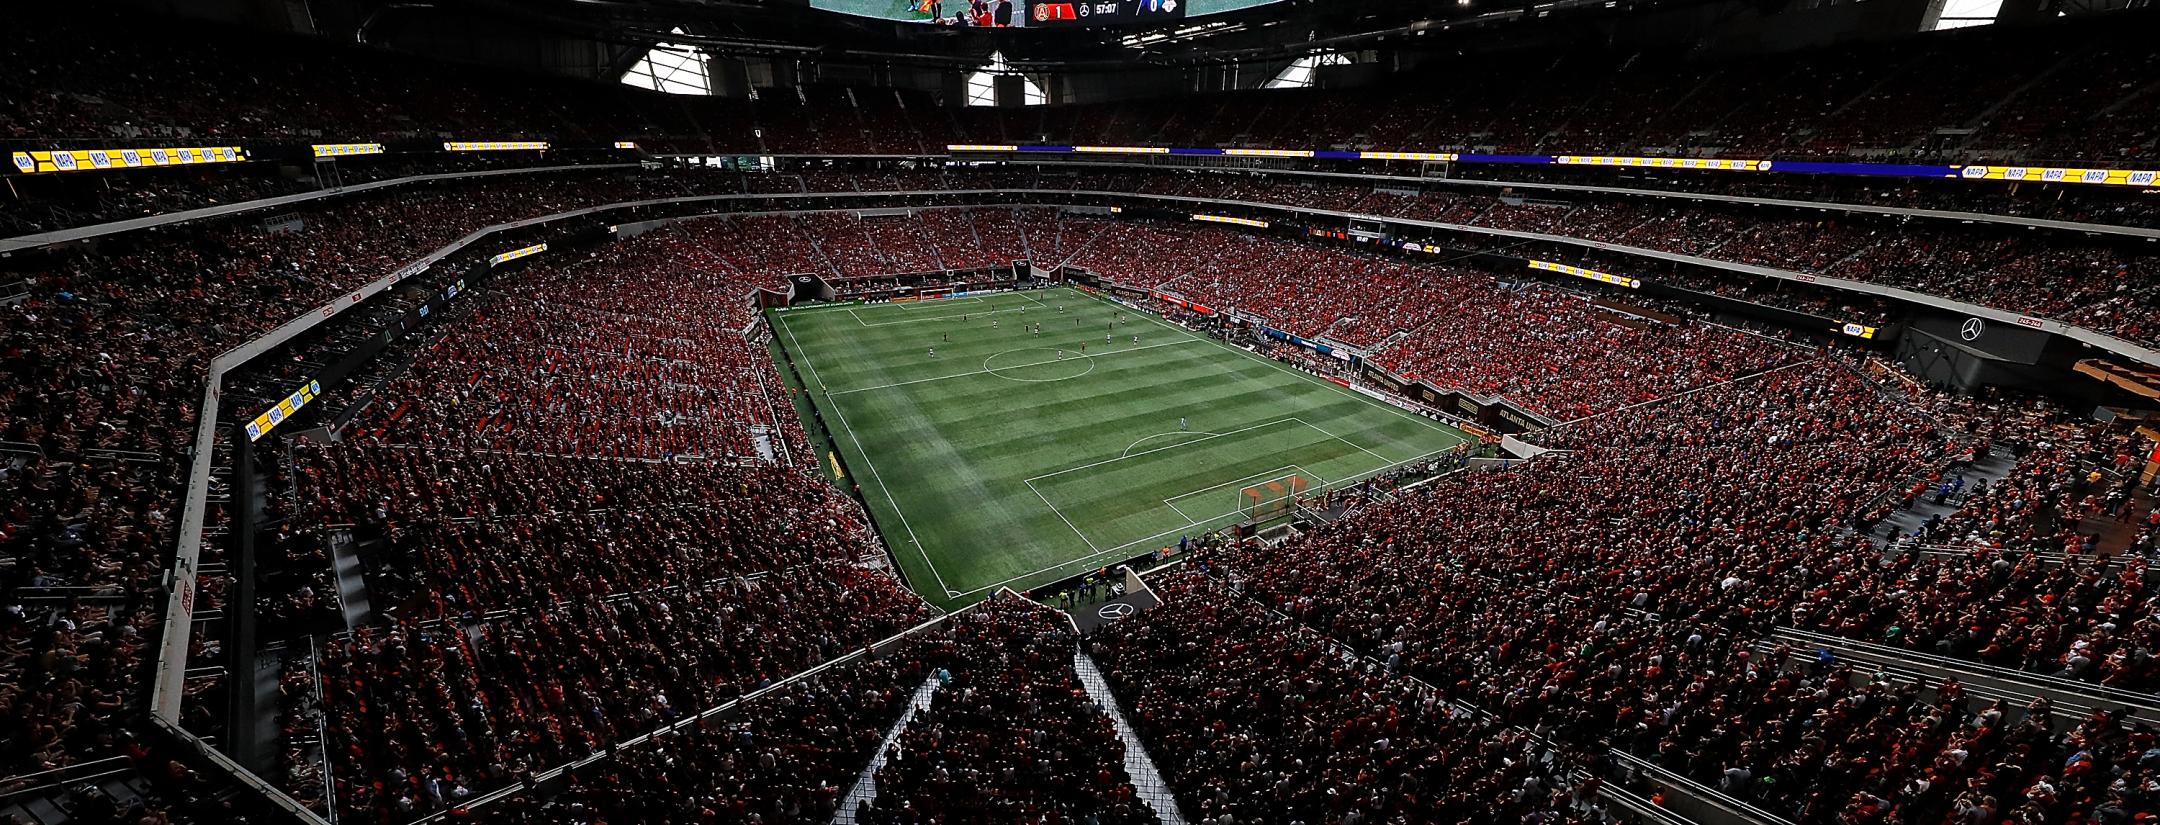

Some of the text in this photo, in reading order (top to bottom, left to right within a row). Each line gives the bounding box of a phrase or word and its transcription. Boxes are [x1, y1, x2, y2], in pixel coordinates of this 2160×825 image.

[1056, 6, 1061, 18] 1
[1096, 4, 1116, 14] 57:07
[54, 153, 75, 168] NAPA
[91, 152, 108, 167] NAPA
[123, 151, 139, 164] NAPA
[1966, 168, 1984, 176] NAPA
[2007, 169, 2023, 177] NAPA
[2045, 170, 2062, 178] NAPA
[2085, 171, 2104, 181] NAPA
[2130, 172, 2152, 183] NAPA
[1368, 370, 1384, 384] ATLANTA
[269, 408, 282, 424] NAPA
[1500, 409, 1525, 428] ATLANTA
